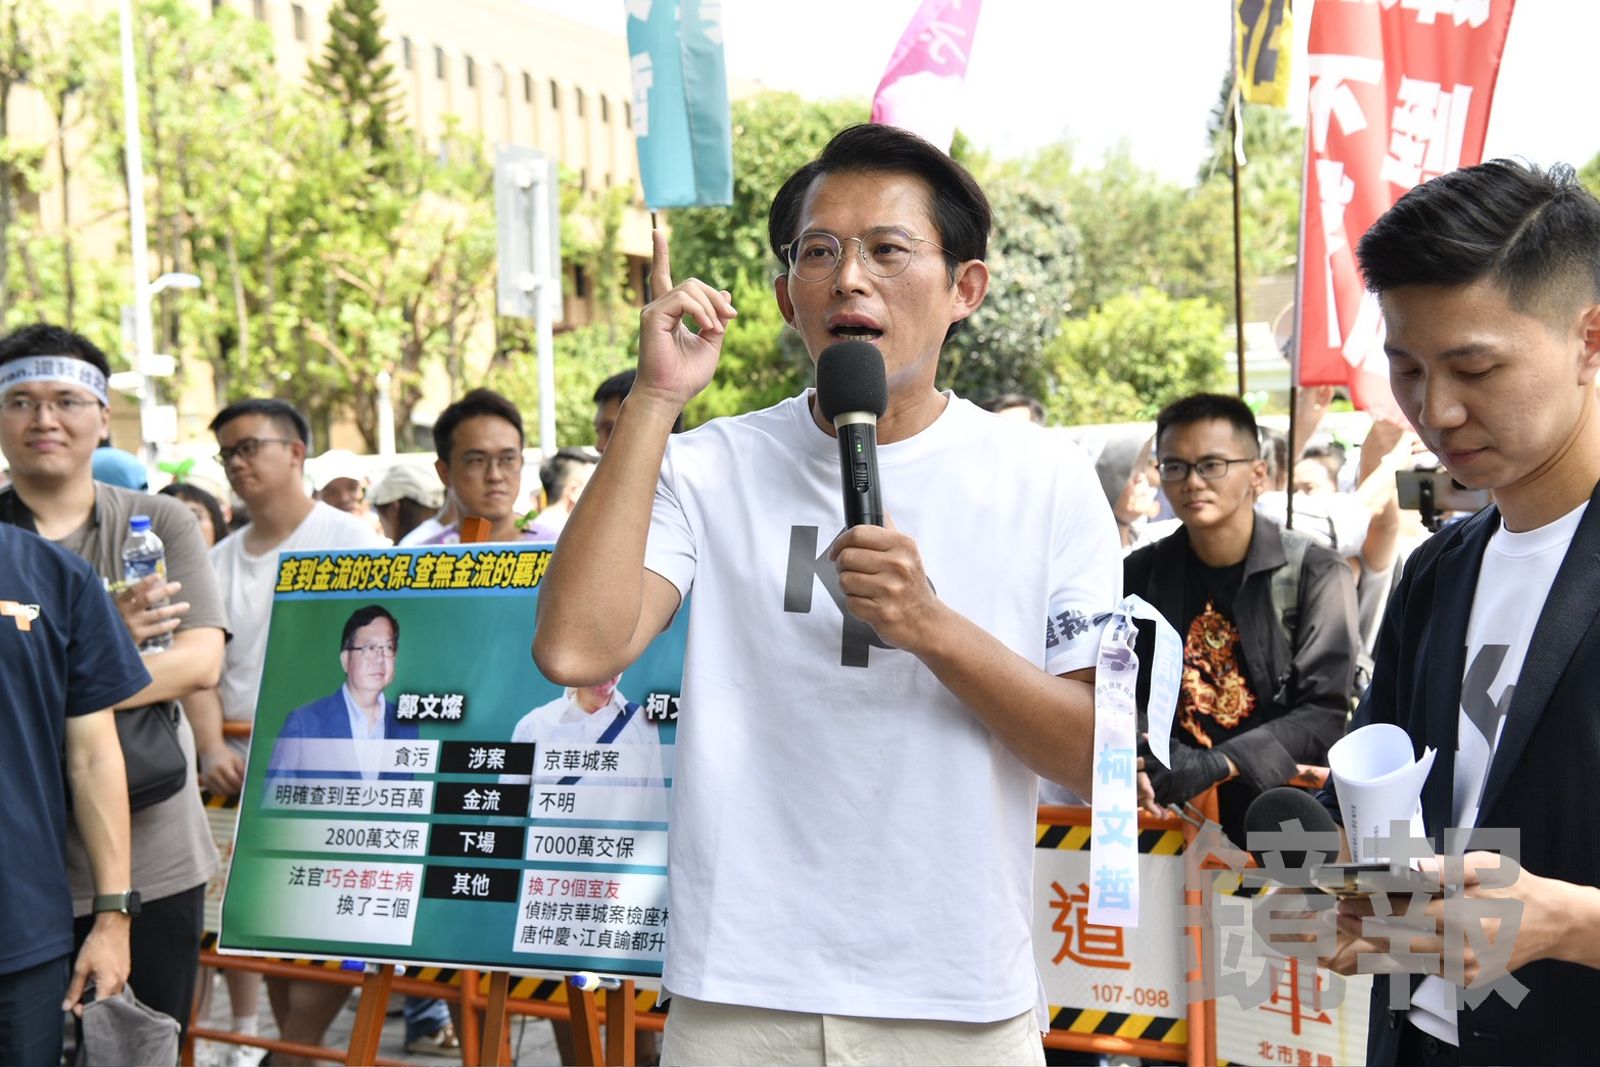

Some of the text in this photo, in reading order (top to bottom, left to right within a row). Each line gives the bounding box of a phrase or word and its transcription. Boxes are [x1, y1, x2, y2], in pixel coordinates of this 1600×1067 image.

[397, 694, 464, 720] 鄭文燦
[394, 746, 430, 767] 貪污
[468, 747, 505, 770] 涉案
[543, 749, 620, 772] 京華城案
[275, 784, 425, 808] 明確查到至少5百萬
[462, 788, 501, 811] 金流
[538, 792, 576, 813] 不明
[324, 827, 420, 850] 2800萬交保
[1094, 743, 1136, 911] 柯文哲
[459, 831, 496, 854] 下場
[534, 835, 635, 859] 7000萬交保
[288, 865, 415, 893] 法官巧合都生病
[451, 872, 491, 897] 其他
[528, 876, 621, 900] 換了9個室友
[336, 895, 411, 919] 換了三個
[1049, 880, 1132, 971] 道
[520, 925, 666, 952] 唐仲慶、江貞諭都升
[1092, 984, 1169, 1009] 107-098
